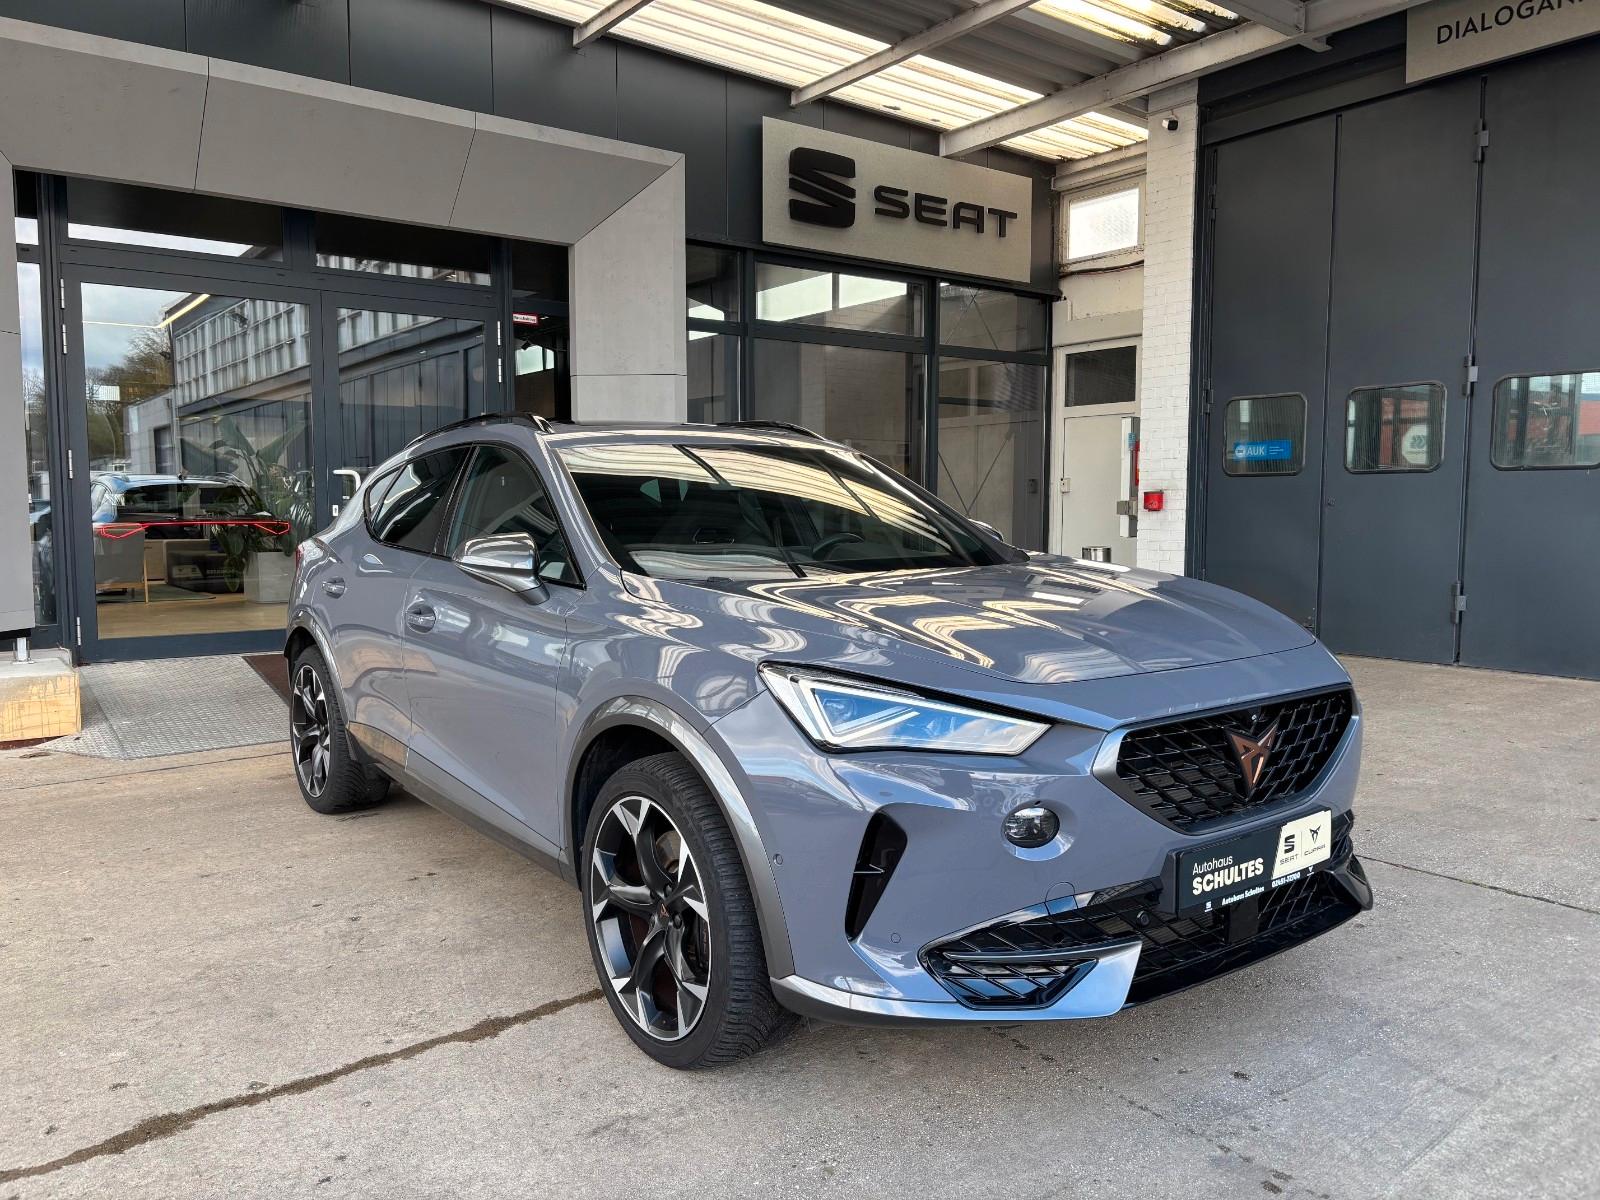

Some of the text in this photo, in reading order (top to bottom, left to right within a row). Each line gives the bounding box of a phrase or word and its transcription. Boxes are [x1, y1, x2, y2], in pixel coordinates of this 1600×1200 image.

[1437, 0, 1583, 44] DIALOGA
[873, 185, 1018, 238] SEAT
[1247, 446, 1265, 456] AUK
[1192, 855, 1233, 876] Autohaus
[1280, 854, 1299, 865] SEAT
[1192, 857, 1264, 896] SCHULTES
